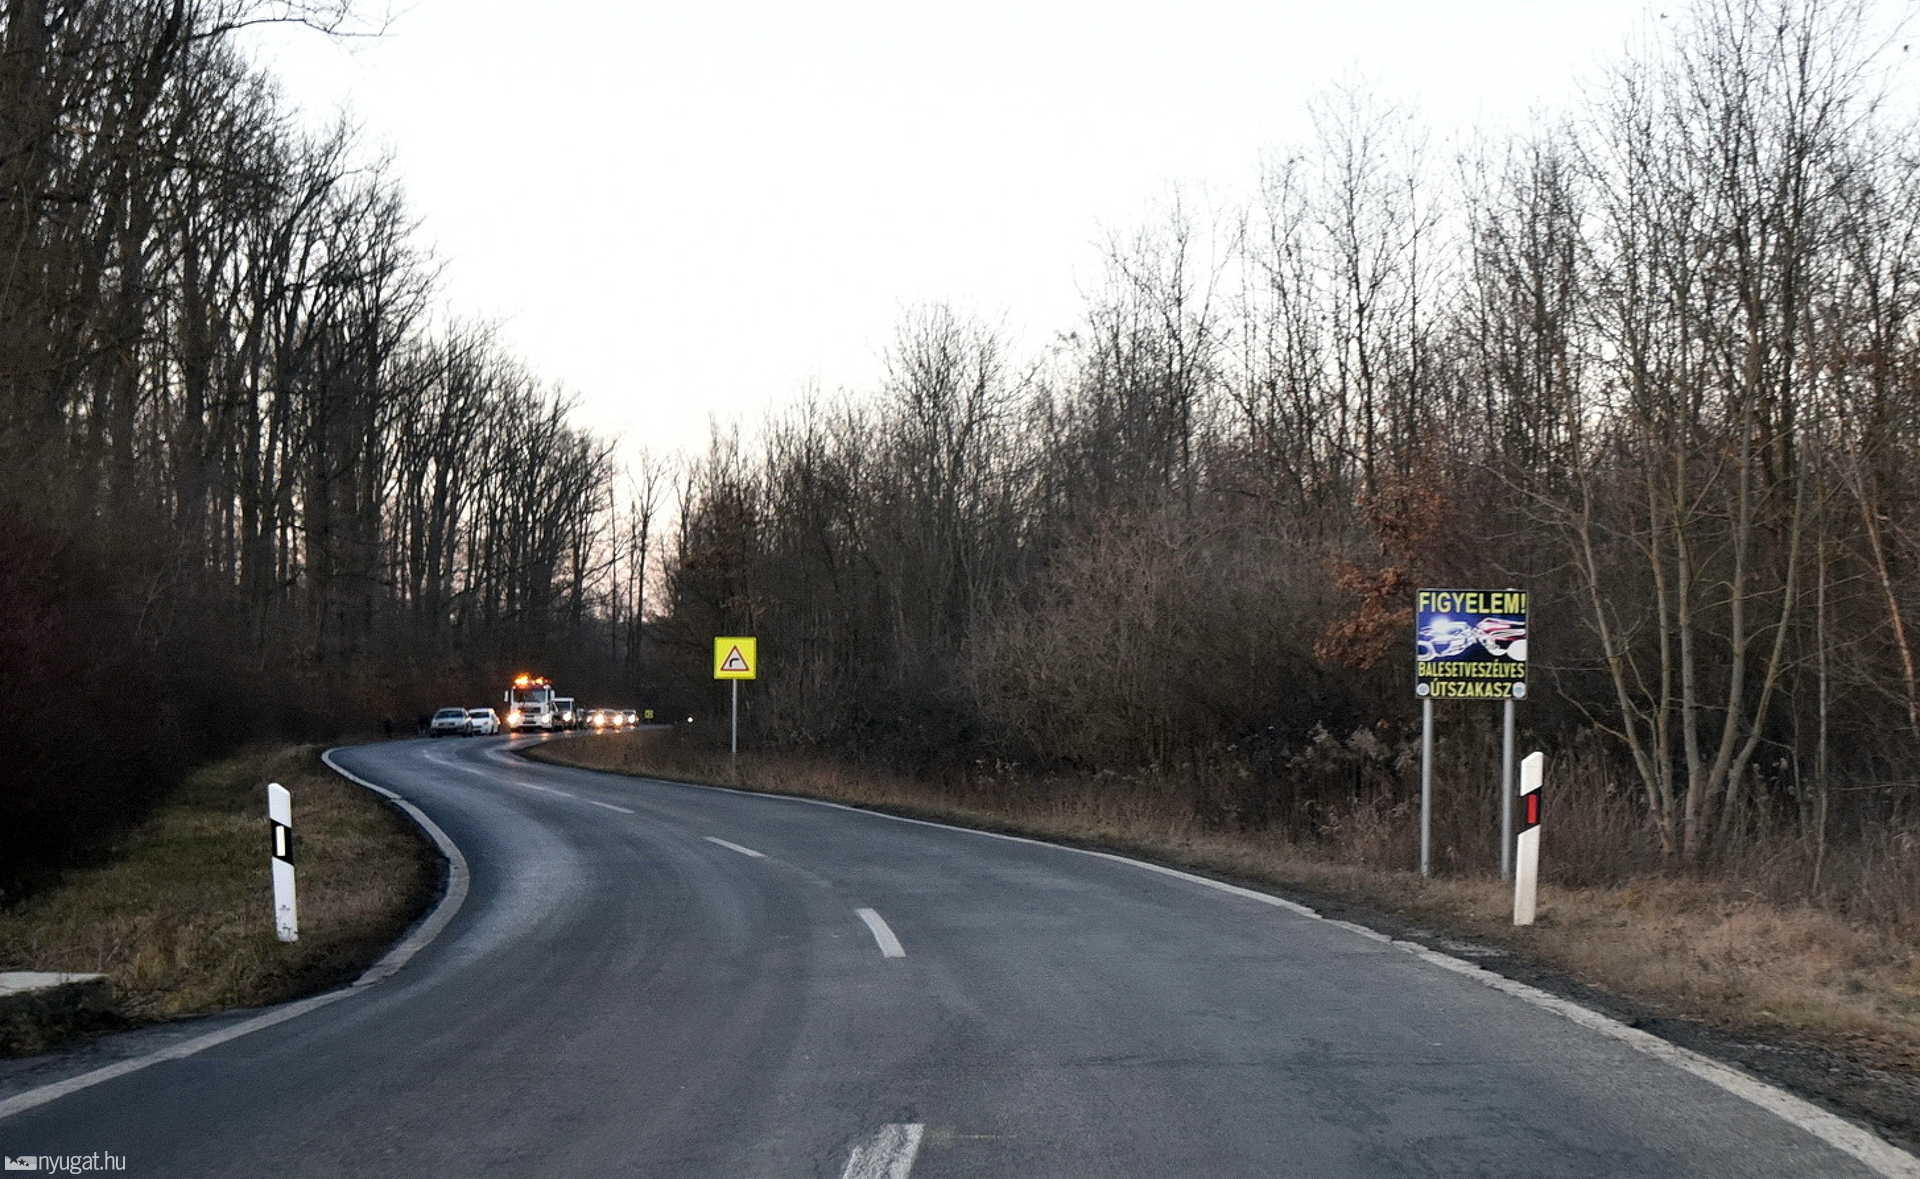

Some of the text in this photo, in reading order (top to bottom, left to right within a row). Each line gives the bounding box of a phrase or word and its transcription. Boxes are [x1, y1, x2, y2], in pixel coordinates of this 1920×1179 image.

[1419, 592, 1526, 614] FIGYELEM!
[1418, 659, 1525, 678] BALESETVESZÉLYES
[1430, 678, 1512, 697] ÚTSZAKASZ
